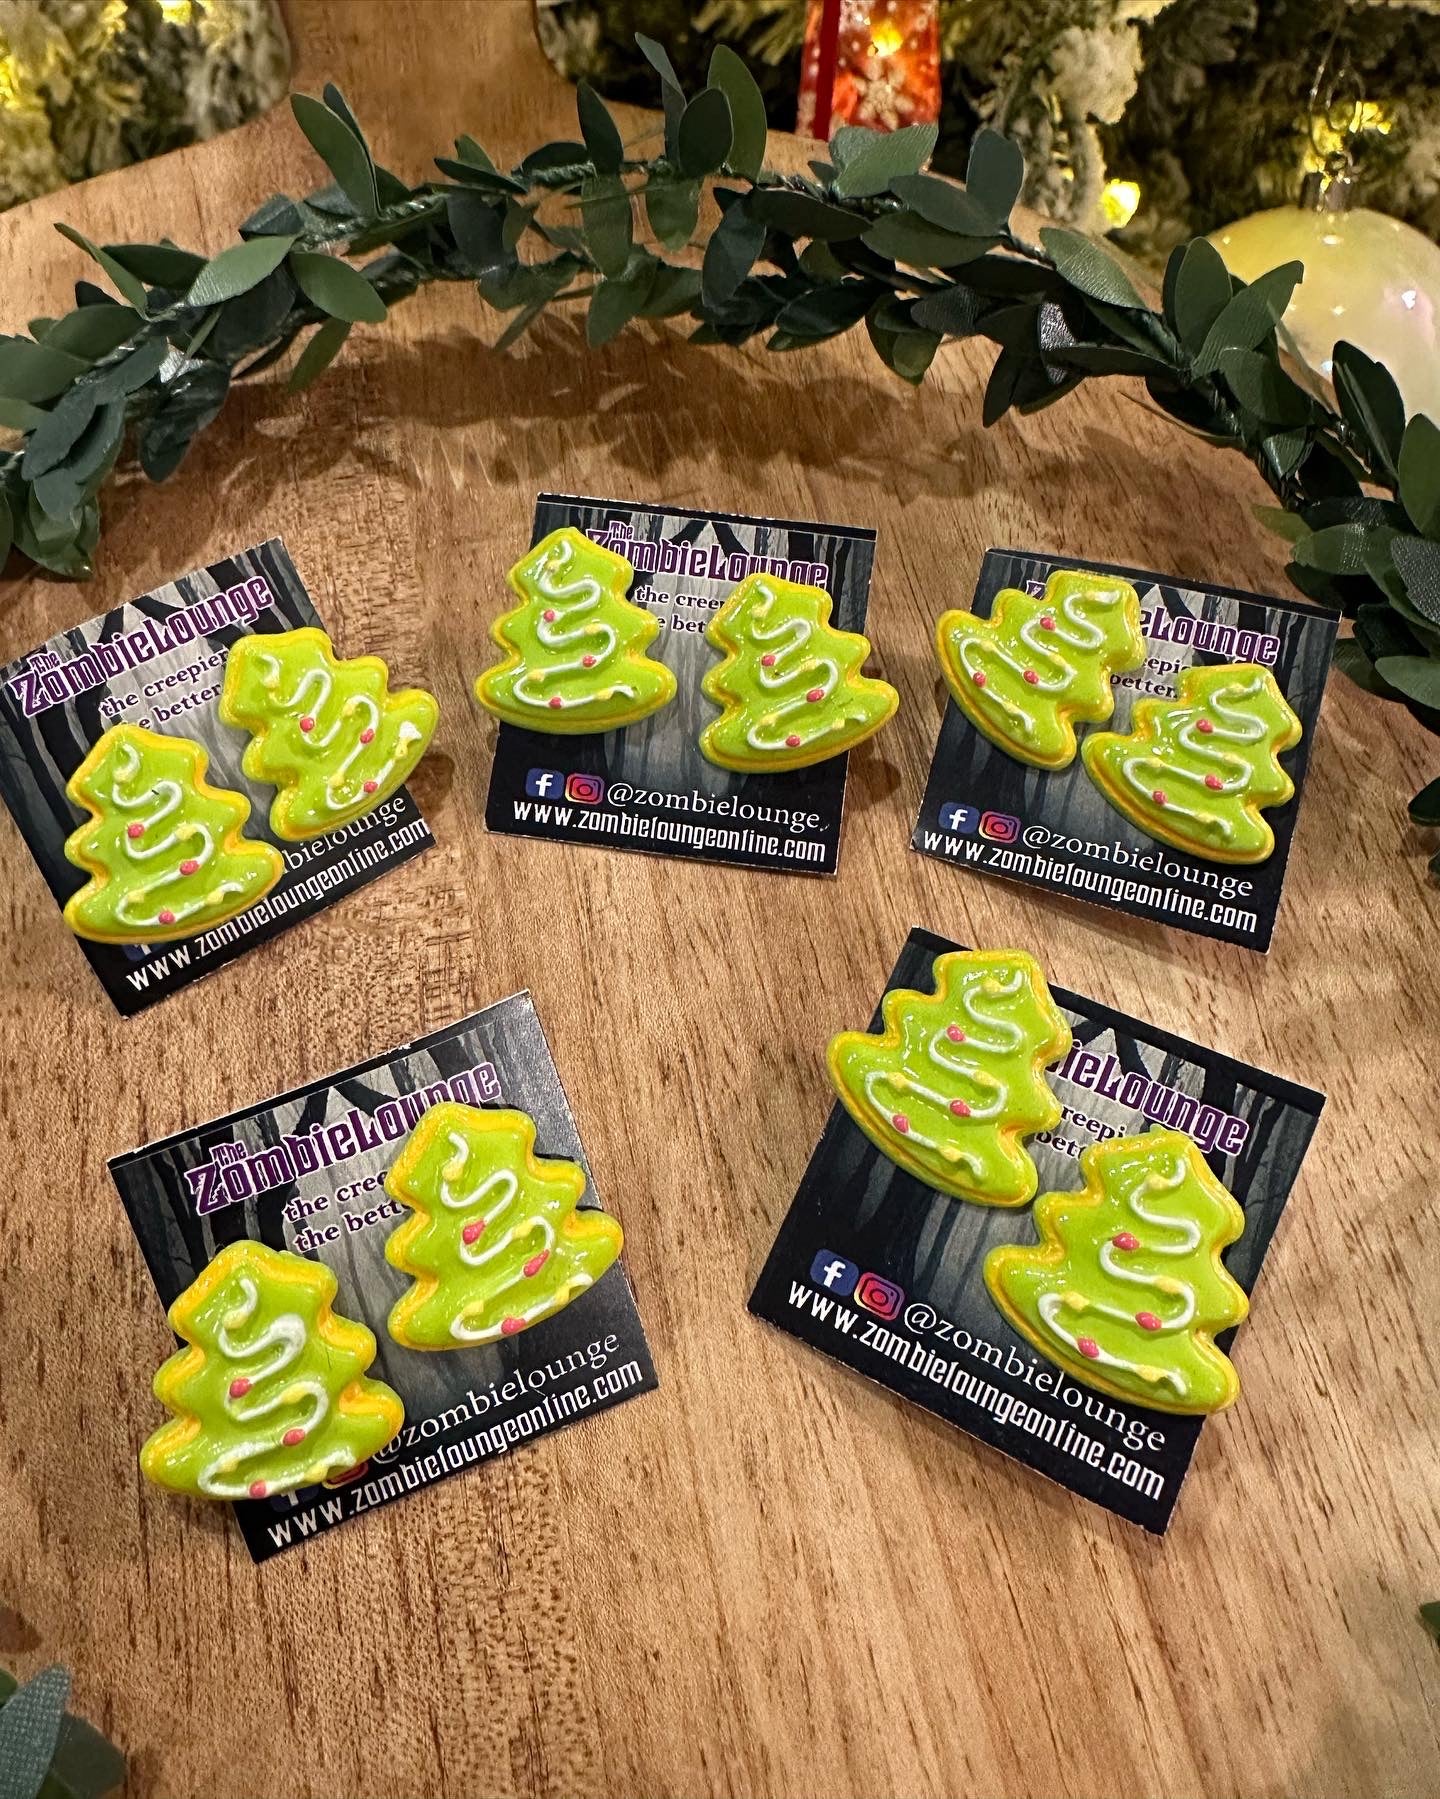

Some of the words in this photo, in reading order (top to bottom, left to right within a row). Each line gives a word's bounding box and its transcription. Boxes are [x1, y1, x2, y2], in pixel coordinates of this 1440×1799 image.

[609, 520, 635, 541] The
[636, 586, 669, 604] the
[10, 576, 275, 717] ZombieLounge
[28, 650, 61, 675] The
[99, 693, 139, 717] the
[144, 650, 229, 697] creepier
[513, 801, 826, 863] www.zombieloungeonline.com
[607, 783, 820, 833] @zombielounge
[924, 831, 1257, 933] www.zombieloungeonline.com
[1022, 825, 1254, 899] @zombielounge
[126, 817, 432, 992] www.zombieloungeonline.com
[210, 1143, 247, 1167] The
[284, 1198, 329, 1223] the
[295, 1225, 341, 1252] the
[788, 1281, 1165, 1500] www.zombieloungeonline.com
[904, 1303, 1166, 1452] @zombielounge
[267, 1360, 643, 1548] www.zombieloungeonline.com
